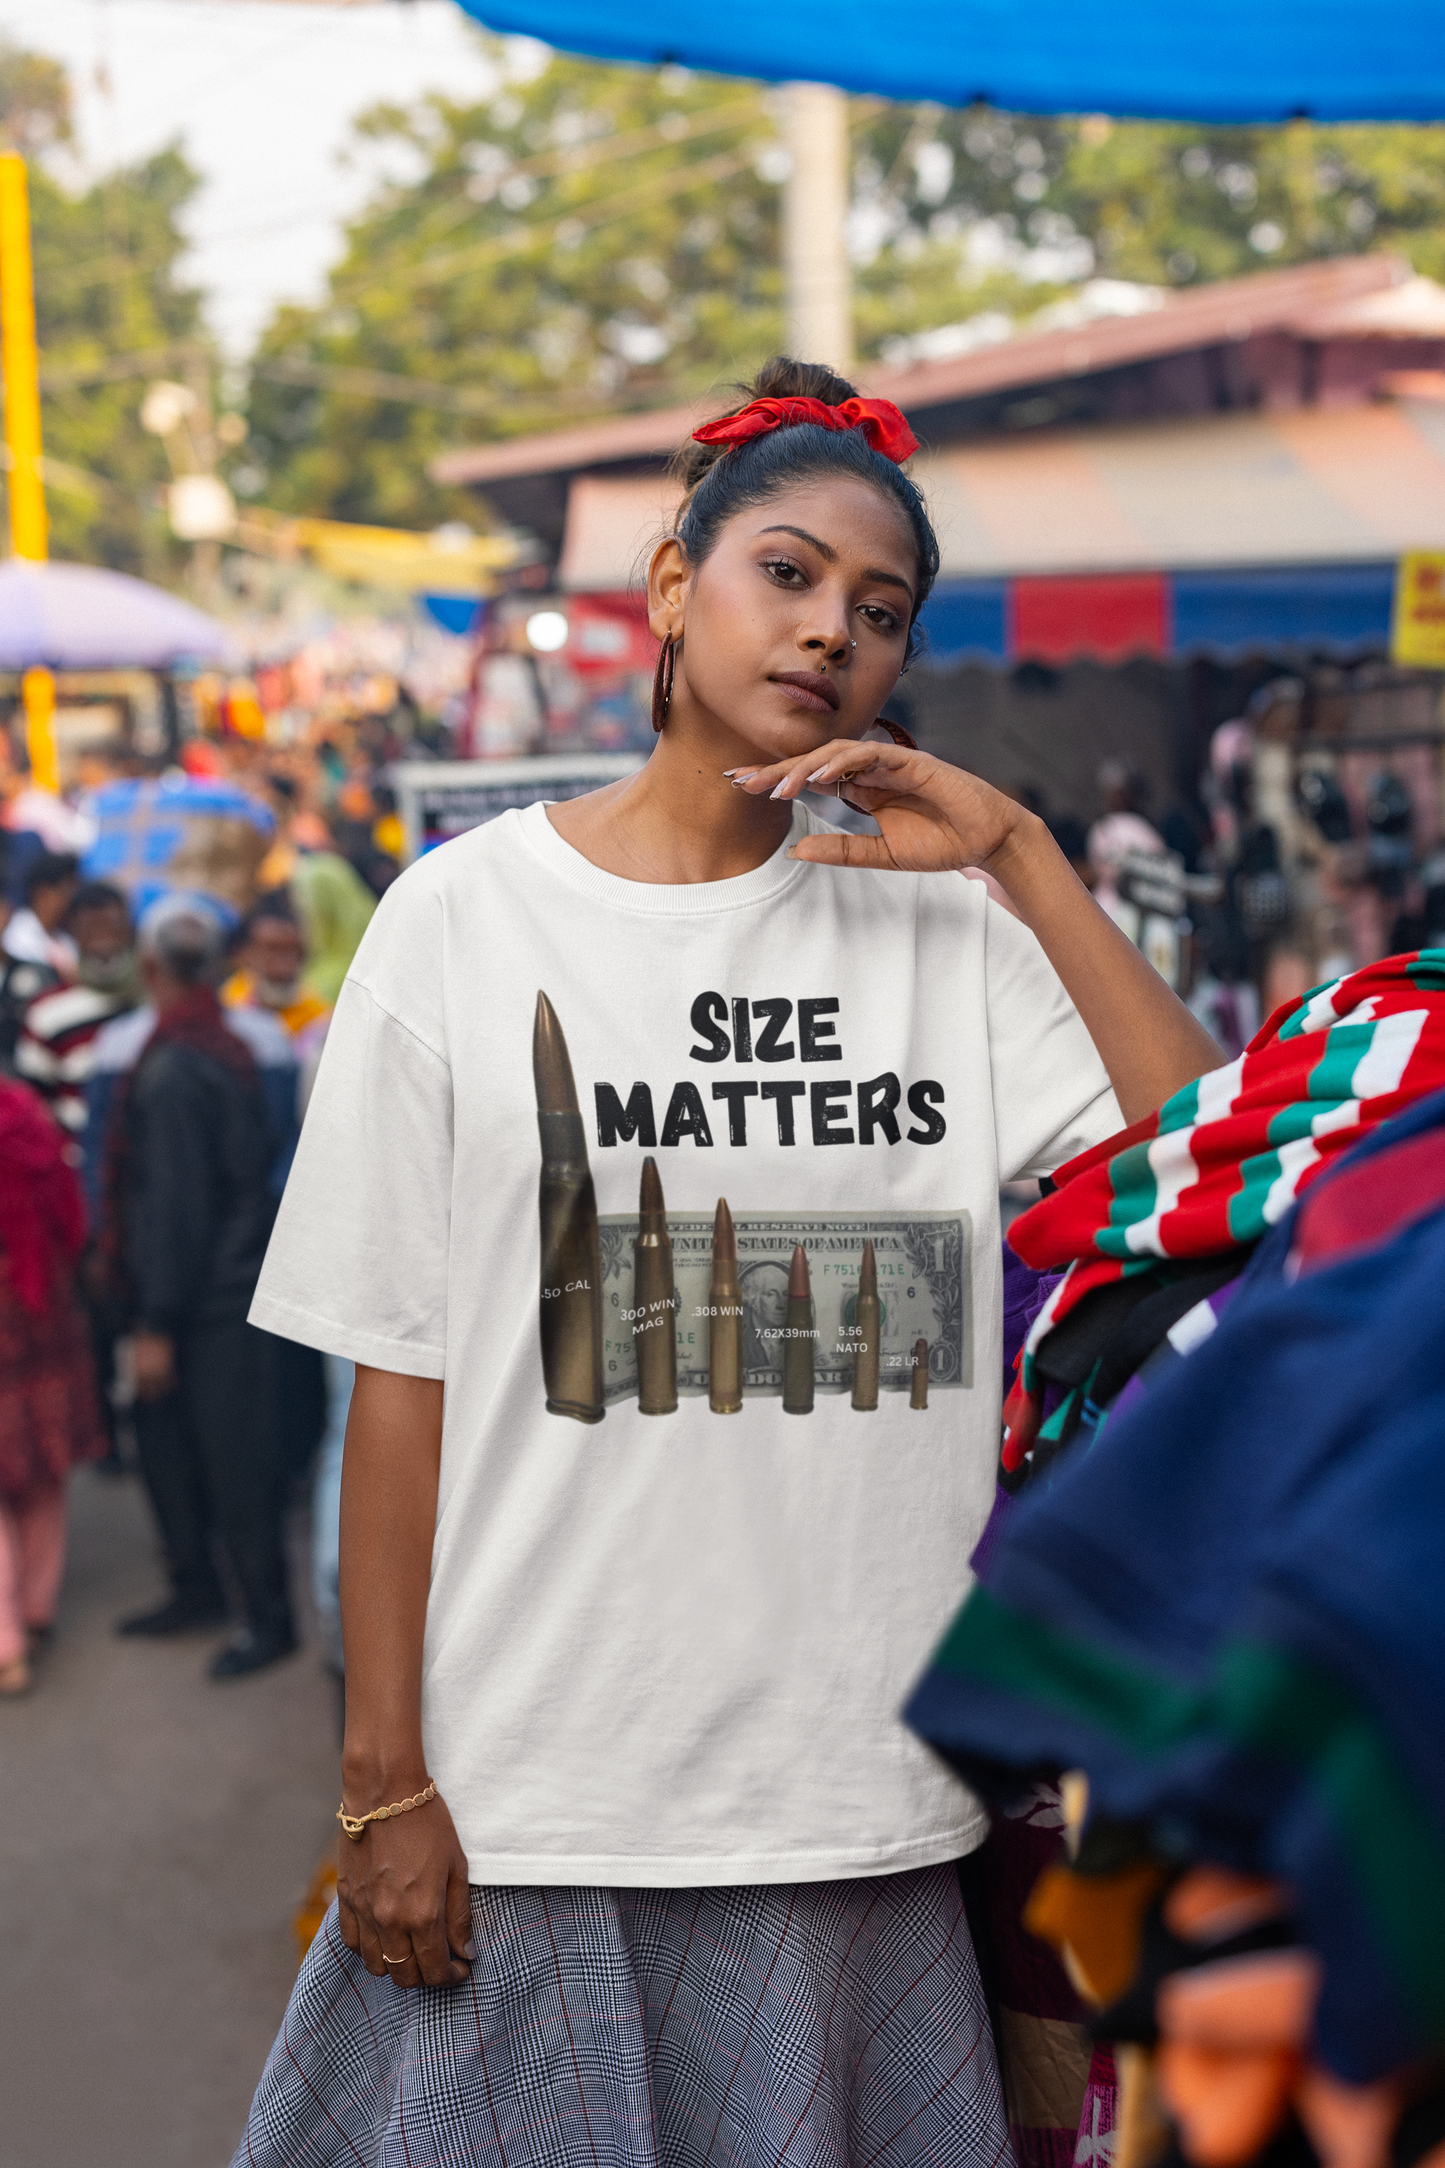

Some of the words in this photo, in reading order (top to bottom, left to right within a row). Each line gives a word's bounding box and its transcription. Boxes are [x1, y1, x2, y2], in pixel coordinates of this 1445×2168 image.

[689, 991, 843, 1063] SIZE
[594, 1072, 947, 1148] MATTERS
[826, 1222, 867, 1231] NOTE
[737, 1237, 799, 1250] STATES
[541, 1288, 561, 1299] .50
[565, 1280, 591, 1292] CAL
[907, 1286, 916, 1299] 6
[620, 1306, 646, 1321] 300
[649, 1299, 675, 1313] WIN
[691, 1306, 717, 1317] .308
[720, 1306, 744, 1316] WIN
[632, 1316, 664, 1335] MAG
[838, 1326, 862, 1336] 5.56
[754, 1328, 820, 1339] 7.62X39mm
[836, 1343, 868, 1353] NATO
[886, 1356, 902, 1367] .22
[905, 1356, 919, 1367] LR
